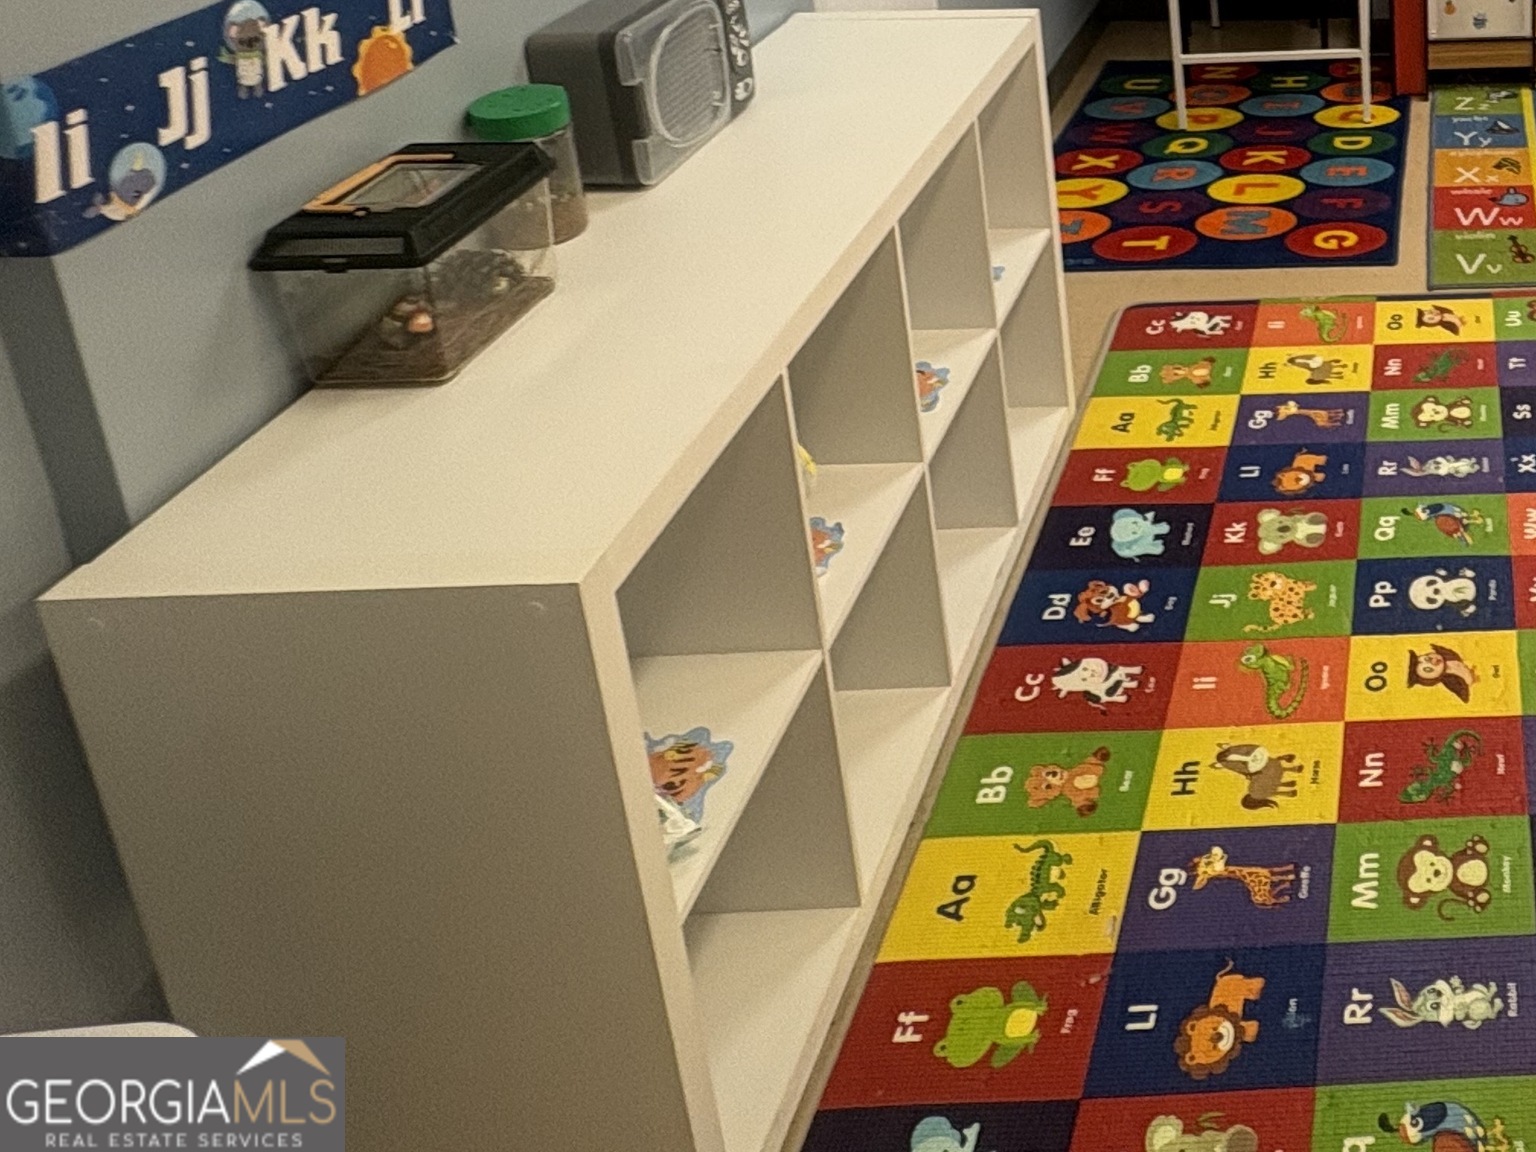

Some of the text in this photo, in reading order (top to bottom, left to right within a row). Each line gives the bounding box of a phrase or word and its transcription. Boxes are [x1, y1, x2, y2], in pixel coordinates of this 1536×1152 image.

[157, 57, 212, 149] Jj
[261, 7, 344, 92] Kk
[1123, 78, 1161, 90] U
[1271, 75, 1309, 88] H
[1164, 137, 1209, 155] Q
[1333, 136, 1372, 149] D
[1072, 154, 1120, 170] X
[1242, 150, 1288, 166] K
[1152, 167, 1198, 182] R
[1326, 166, 1368, 177] E
[1058, 184, 1106, 200] Y
[1234, 182, 1280, 196] L
[1139, 200, 1182, 214] S
[1221, 210, 1272, 235] M
[1122, 235, 1170, 250] T
[1313, 230, 1359, 249] G
[1455, 253, 1503, 275] Vv
[1380, 402, 1400, 429] Mm
[1223, 520, 1247, 543] Kk
[1374, 516, 1397, 540] Qq
[1369, 580, 1397, 608] Pp
[1488, 579, 1497, 601] Panda
[1042, 593, 1072, 621] Dd
[1015, 673, 1044, 701] Cc
[1364, 662, 1388, 691] Oo
[1171, 760, 1199, 796] Hh
[1358, 752, 1385, 787] Nn
[976, 765, 1014, 804] Bb
[1298, 865, 1311, 900] Giraffe
[1351, 852, 1380, 909] Mm
[1501, 854, 1513, 894] Monkey
[937, 874, 979, 921] Aa
[1088, 868, 1110, 916] Alligator
[1148, 867, 1186, 910] Gg
[1343, 987, 1374, 1025] Rr
[1507, 982, 1518, 1017] Rabbit
[893, 1011, 930, 1043] Ff
[1060, 1008, 1078, 1034] Frog
